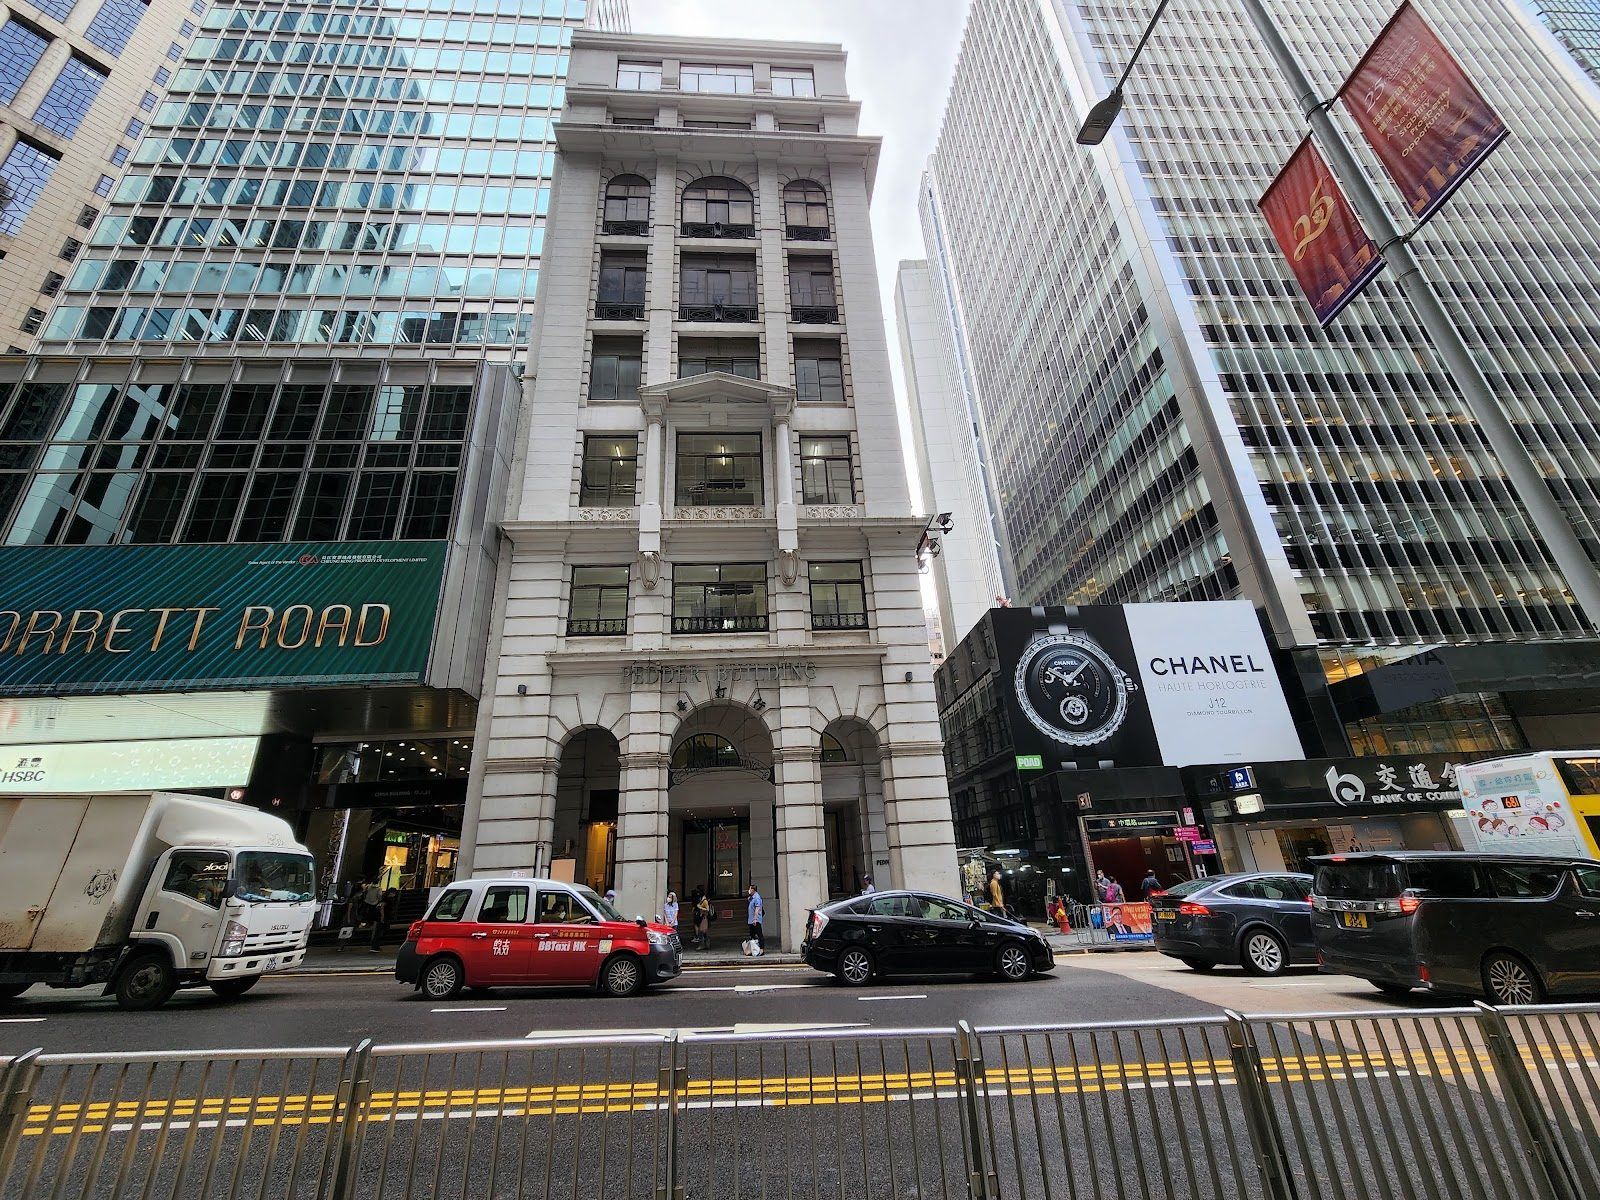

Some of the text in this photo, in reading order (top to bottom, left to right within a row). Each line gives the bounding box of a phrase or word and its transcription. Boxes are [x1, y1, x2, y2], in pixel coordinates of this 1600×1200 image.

[1387, 90, 1428, 141] A New Era
[1409, 87, 1451, 136] Prosperity
[1399, 99, 1431, 137] Stability
[1401, 100, 1450, 157] Opportunity
[234, 603, 391, 650] ROAD
[1150, 655, 1265, 676] CHANEL
[619, 662, 817, 685] PEDDER BUILDING
[1158, 680, 1267, 692] HAUTE HORLOGERIE
[1208, 697, 1227, 709] J12
[1017, 757, 1041, 767] POAD
[1, 770, 46, 783] HSBC
[1371, 793, 1405, 804] BANK
[1406, 792, 1423, 802] OF
[1505, 797, 1519, 808] 681
[493, 938, 511, 948] 的士
[538, 941, 587, 952] BBTaxi HK
[492, 947, 510, 956] TAXI
